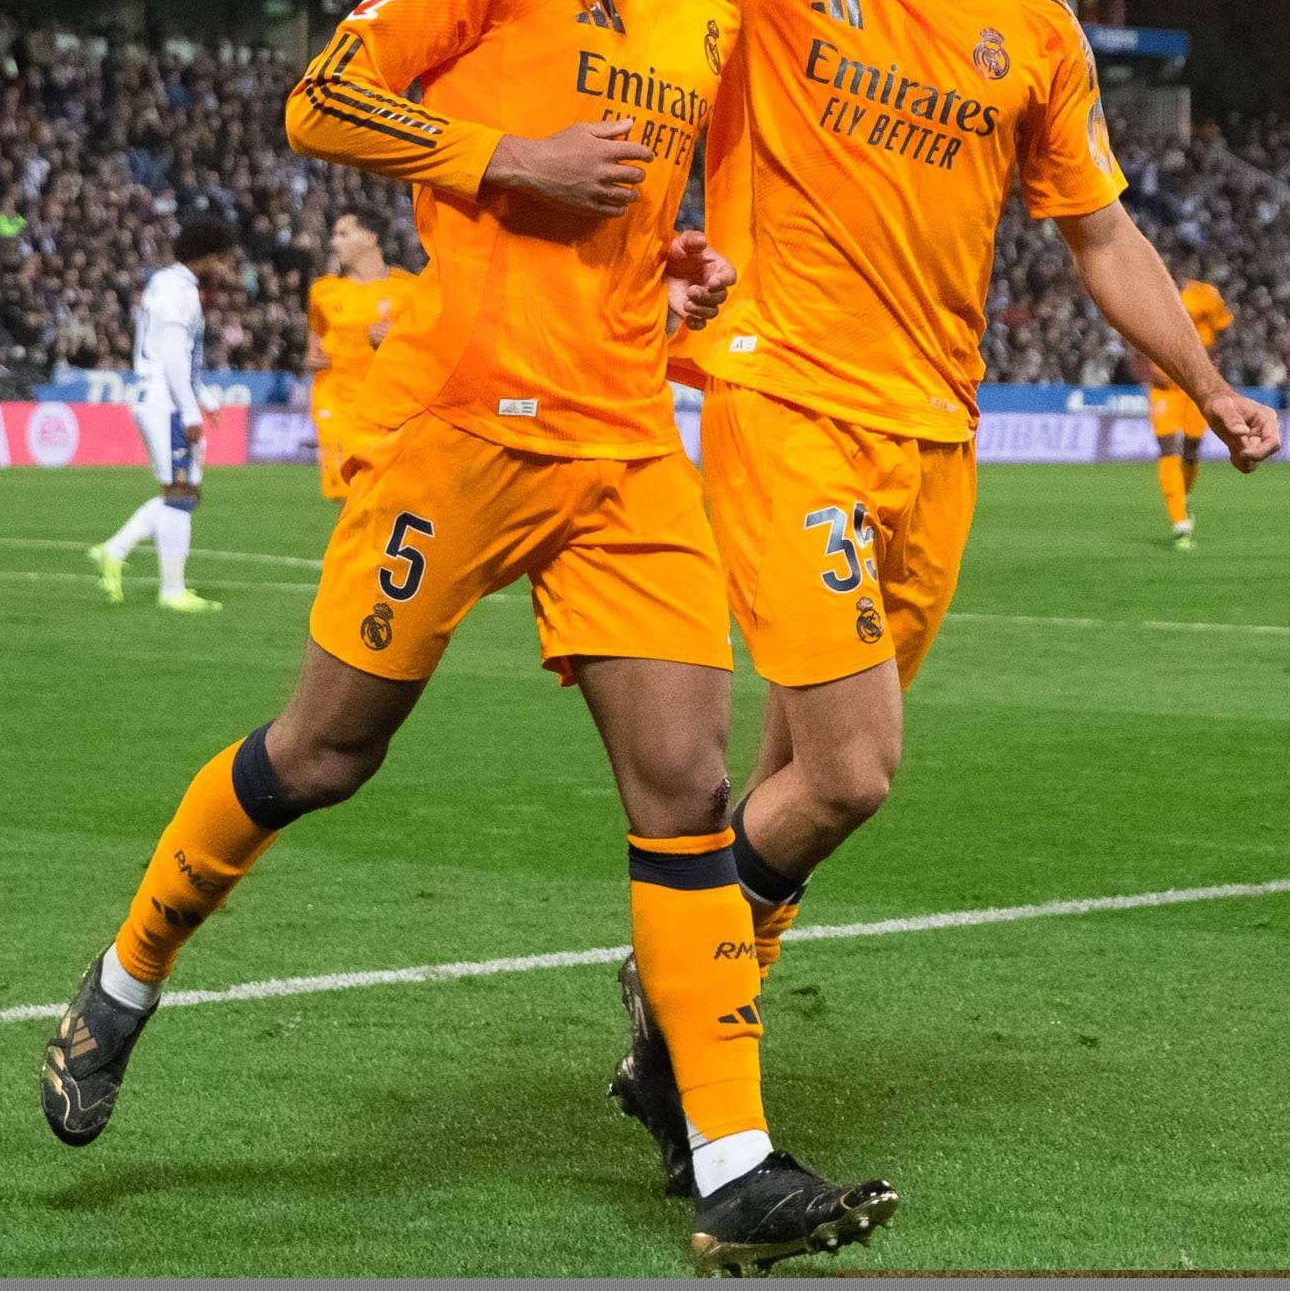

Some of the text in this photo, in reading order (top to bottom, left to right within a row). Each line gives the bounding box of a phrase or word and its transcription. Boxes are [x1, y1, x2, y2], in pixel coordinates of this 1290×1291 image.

[576, 50, 710, 129] Emirate
[805, 37, 999, 137] Emirates
[819, 96, 963, 171] FLY BETTER
[378, 511, 435, 602] 5
